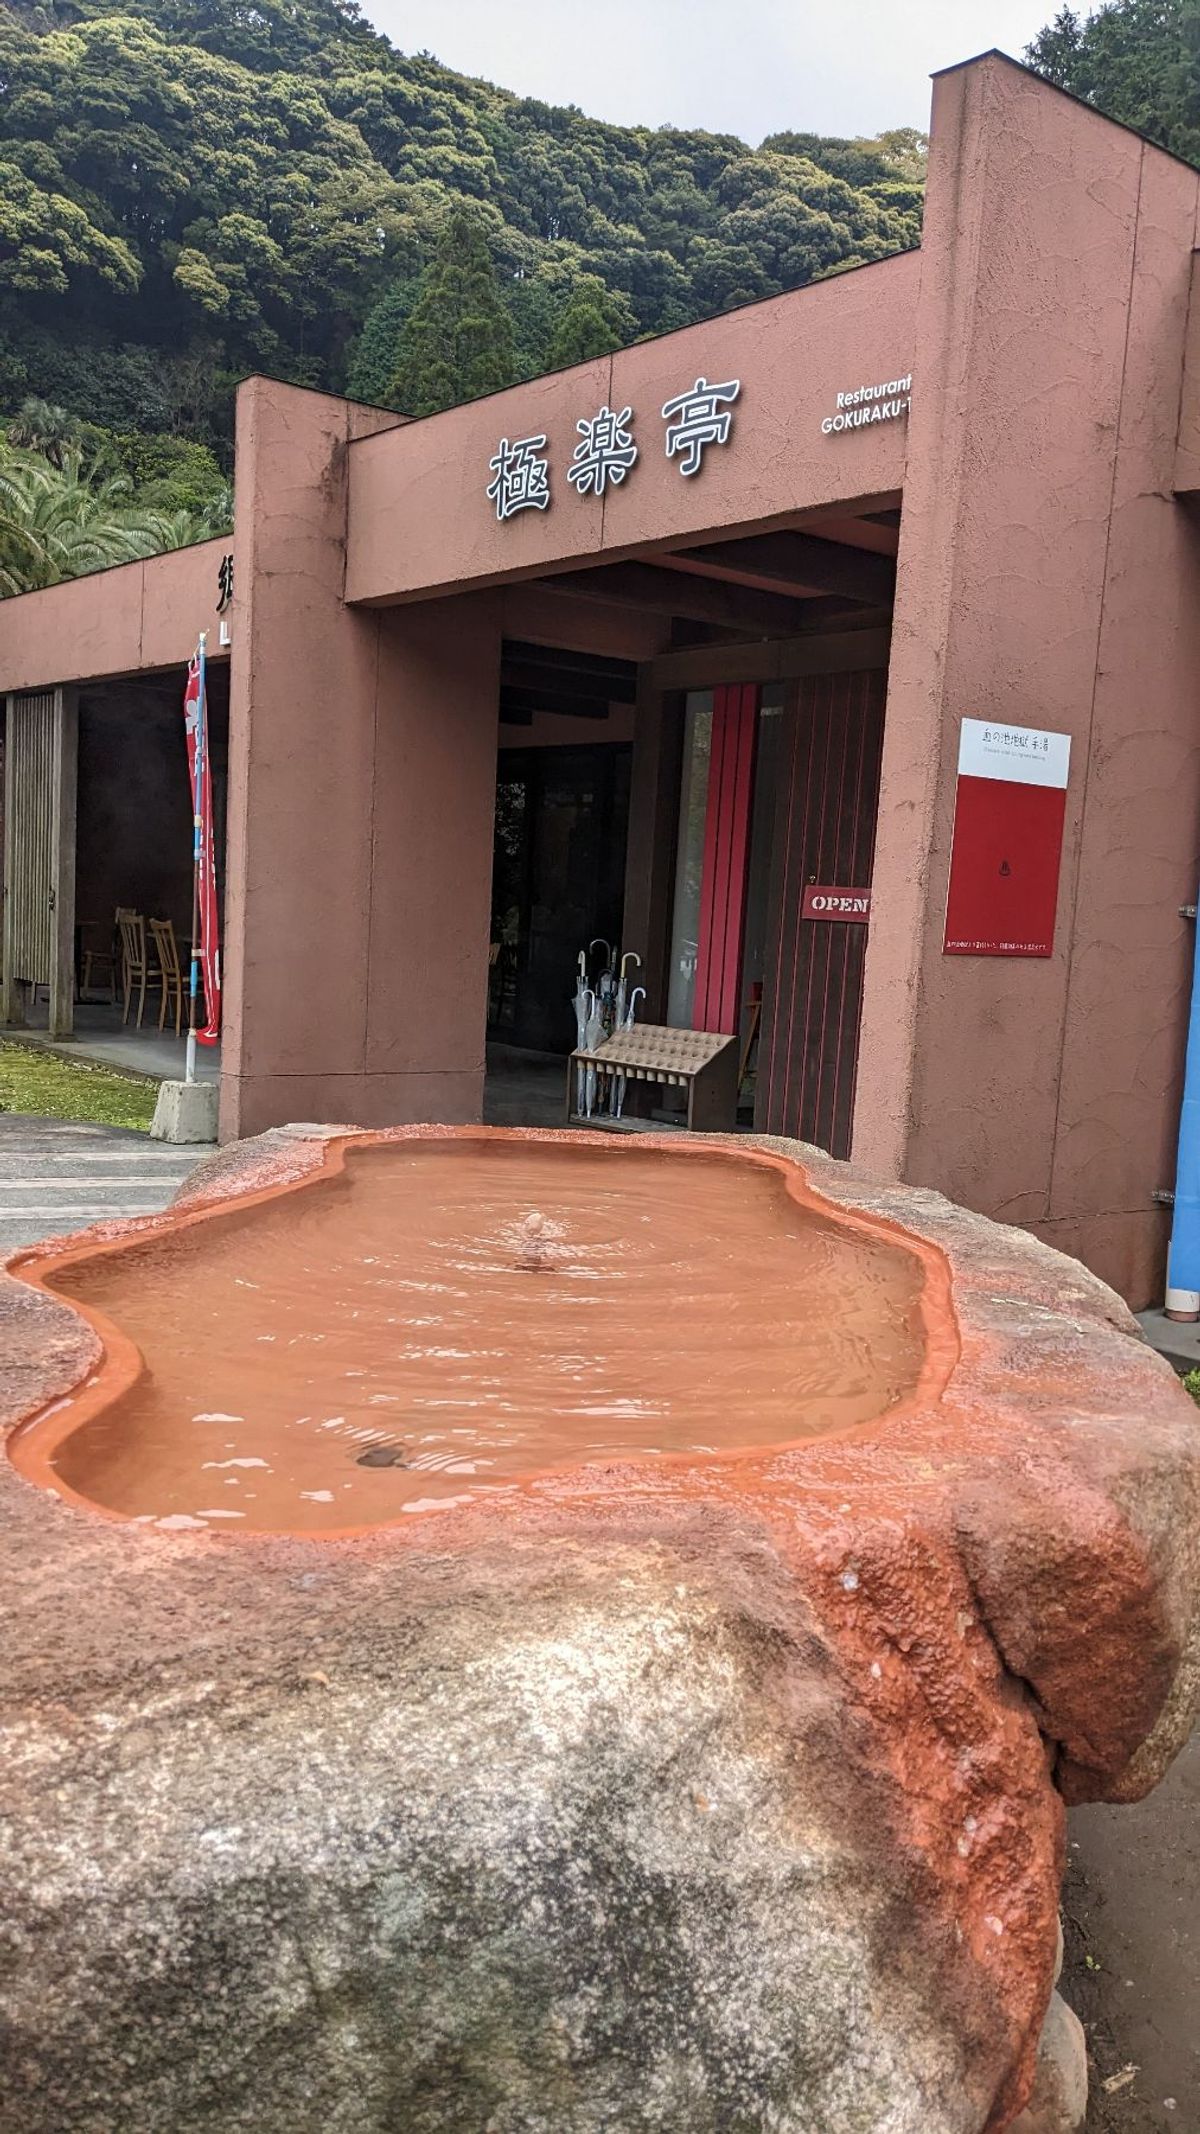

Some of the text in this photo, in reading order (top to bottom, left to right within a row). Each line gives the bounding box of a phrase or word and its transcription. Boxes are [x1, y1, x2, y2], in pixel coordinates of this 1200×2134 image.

[836, 373, 912, 409] Restaurant
[486, 377, 741, 520] 極楽亭
[811, 896, 869, 913] OPEN
